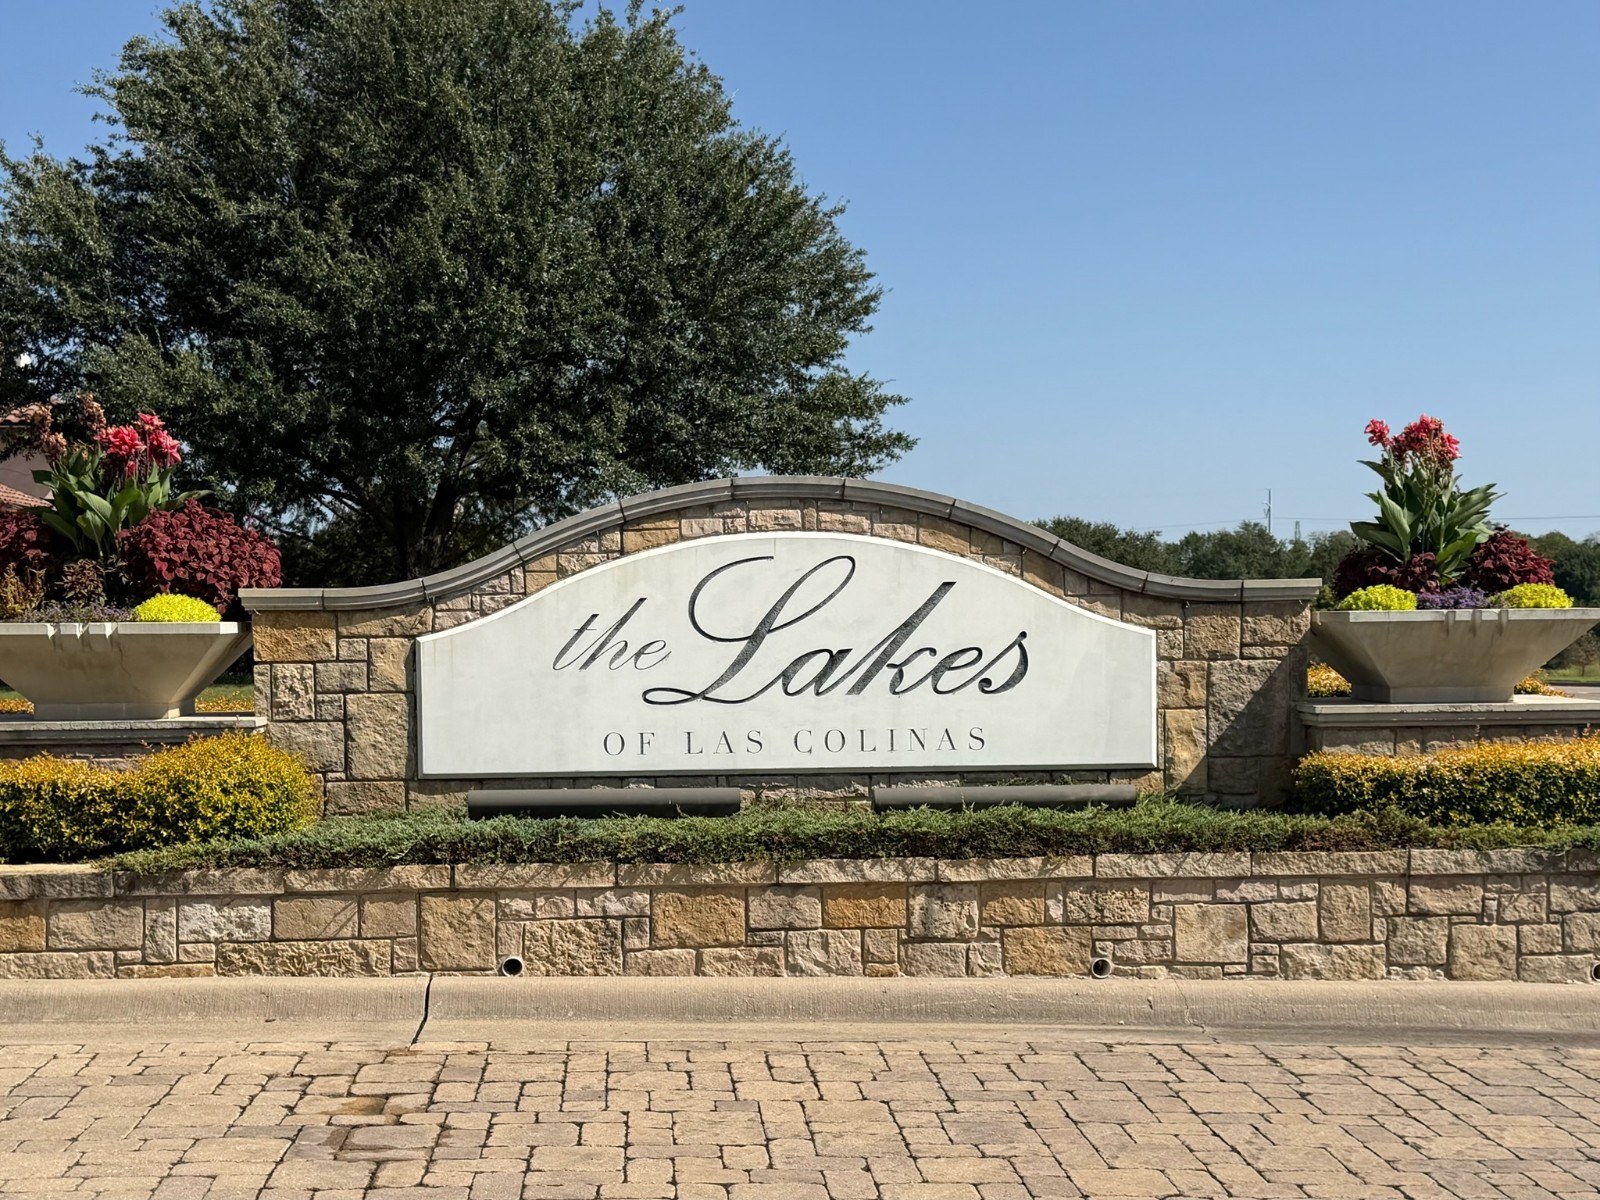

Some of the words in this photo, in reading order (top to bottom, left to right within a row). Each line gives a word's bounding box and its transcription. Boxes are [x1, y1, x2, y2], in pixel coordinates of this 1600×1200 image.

[552, 597, 672, 671] the
[642, 554, 1029, 706] Lakes
[603, 731, 655, 756] OF
[685, 730, 763, 755] LAS
[793, 727, 986, 754] COLINAS
